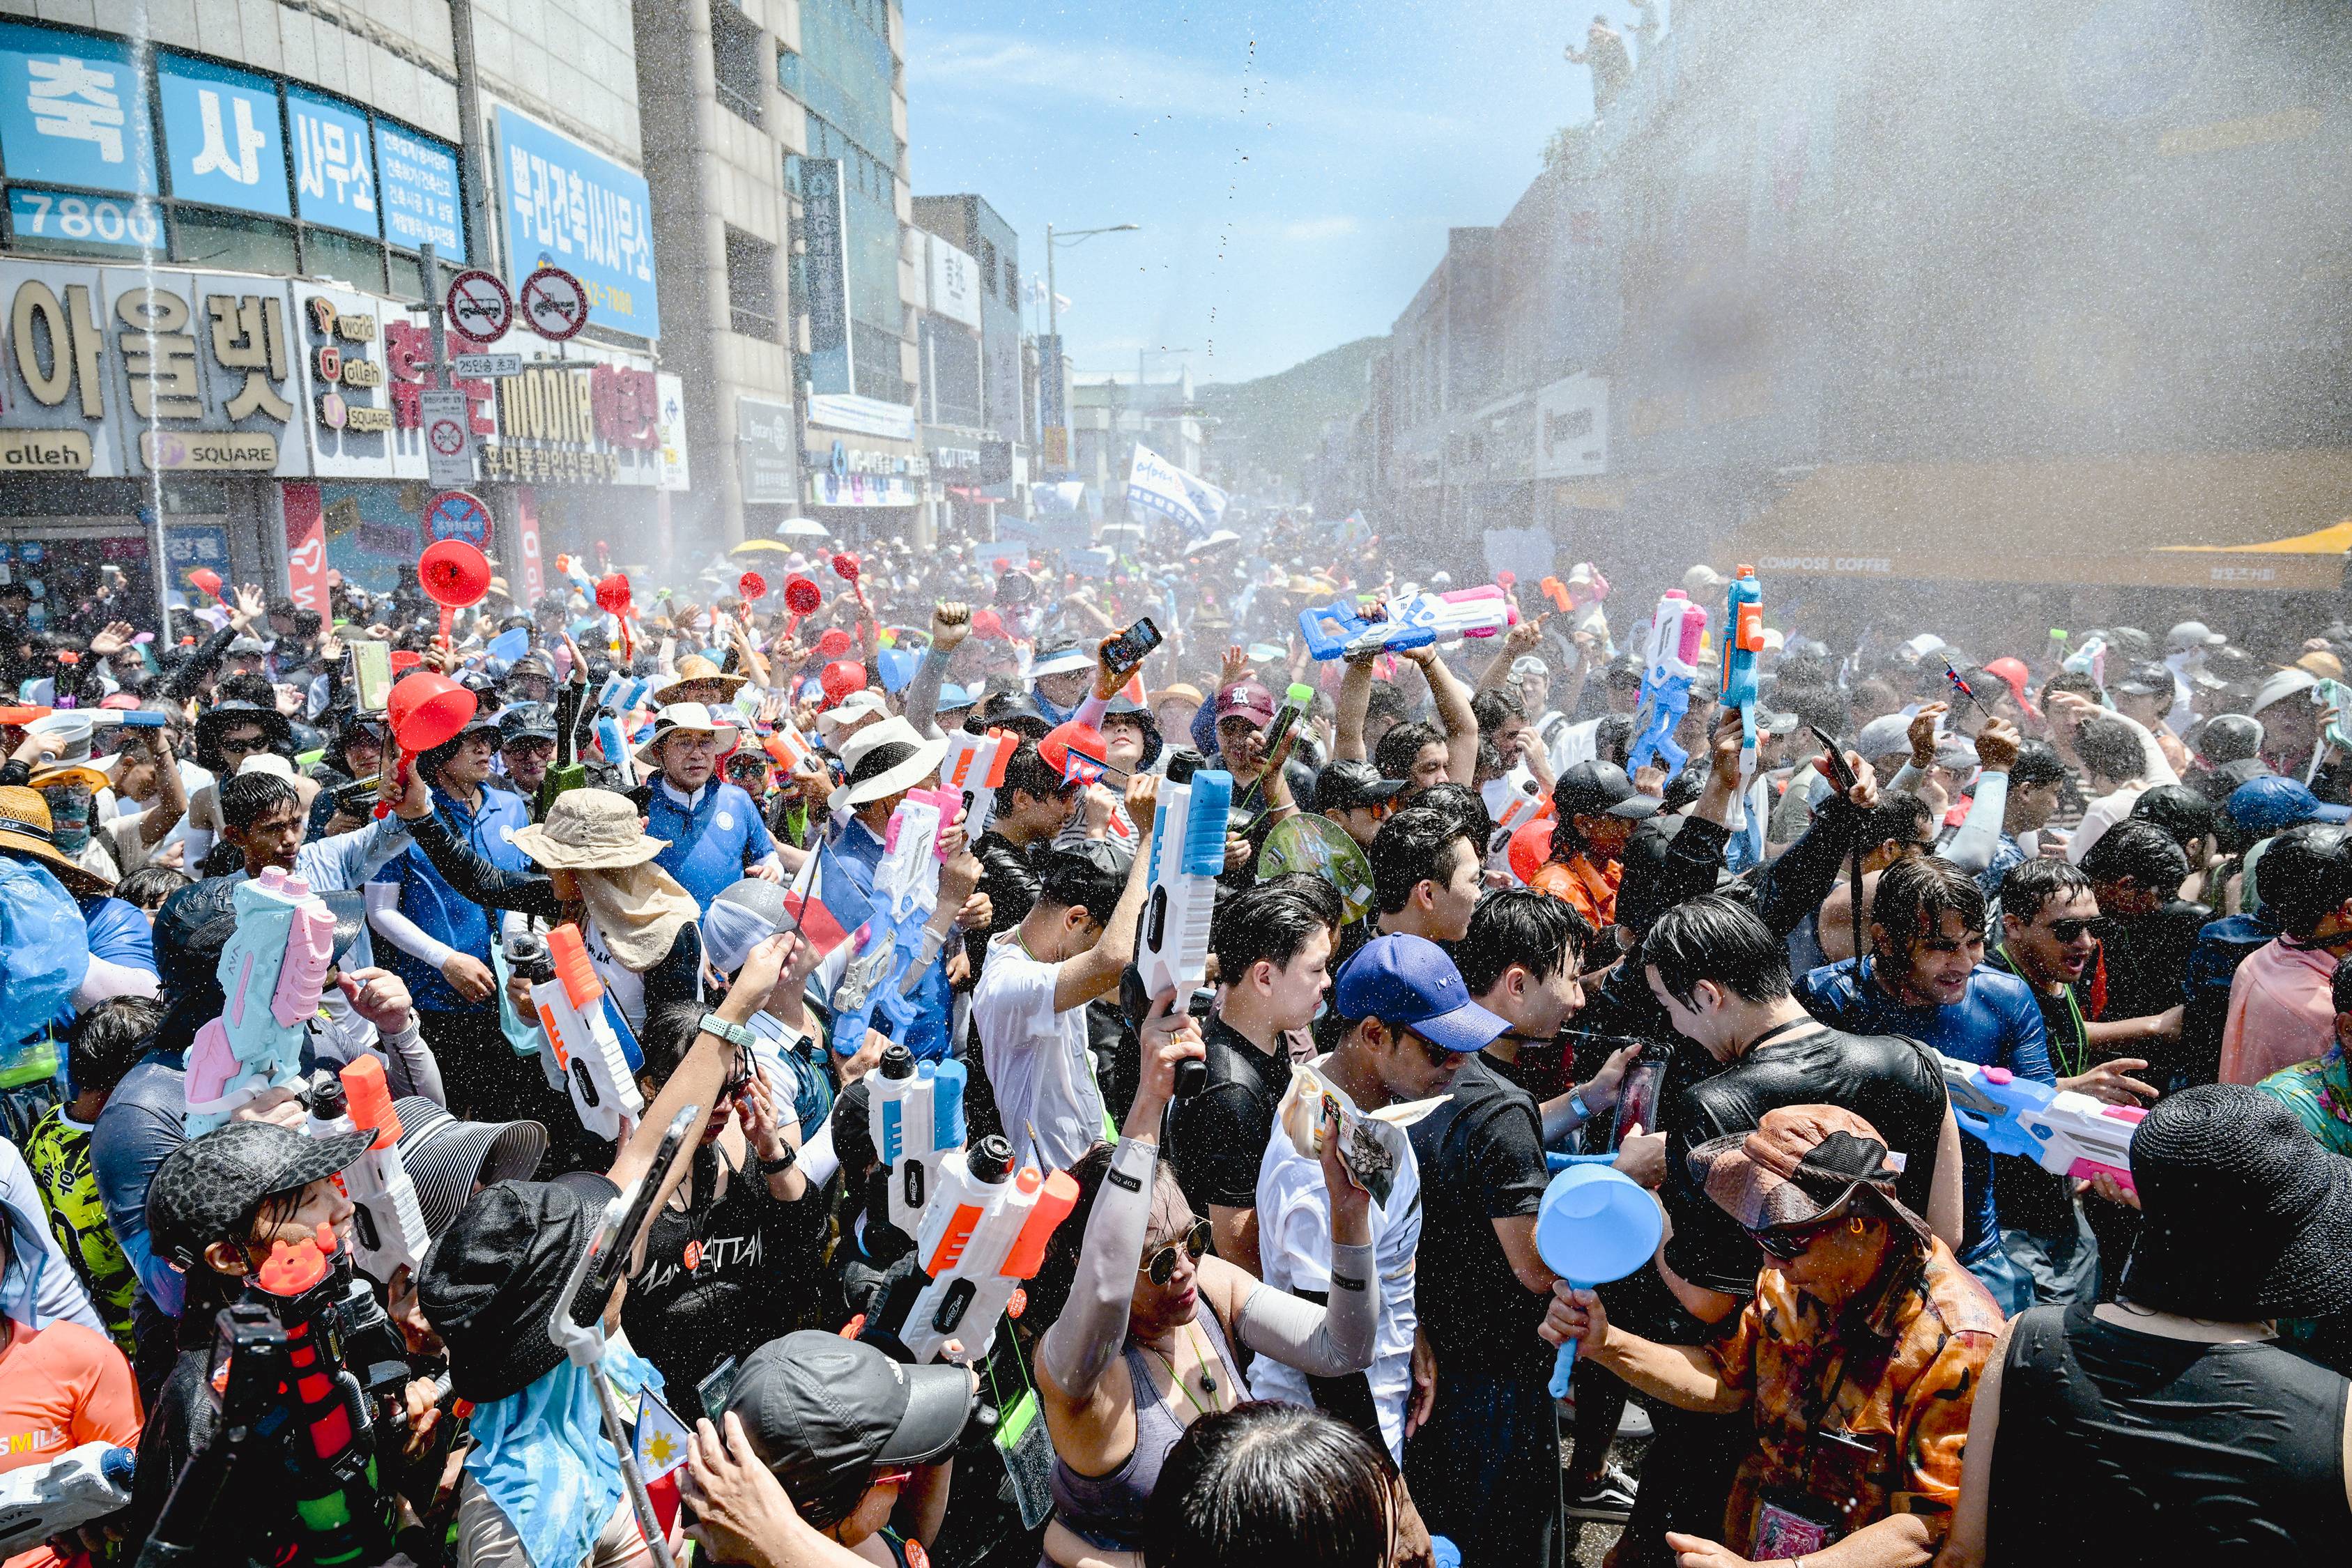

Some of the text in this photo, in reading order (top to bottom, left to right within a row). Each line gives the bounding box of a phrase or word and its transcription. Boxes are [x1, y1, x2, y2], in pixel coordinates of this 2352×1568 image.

[27, 57, 374, 213] 축 사 사무소
[22, 194, 157, 243] 7800
[510, 144, 652, 282] 뿌리건축사사무소
[341, 318, 374, 338] world
[13, 279, 293, 424] 아울렛
[348, 362, 380, 383] olleh
[351, 410, 391, 427] SQUARE
[6, 445, 80, 466] olleh
[192, 447, 273, 463] SQUARE
[1759, 557, 1891, 571] COMPOSE COFFEE
[1232, 686, 1250, 704] R
[1123, 1178, 1137, 1188] TOP
[944, 1294, 964, 1327] Water Gun
